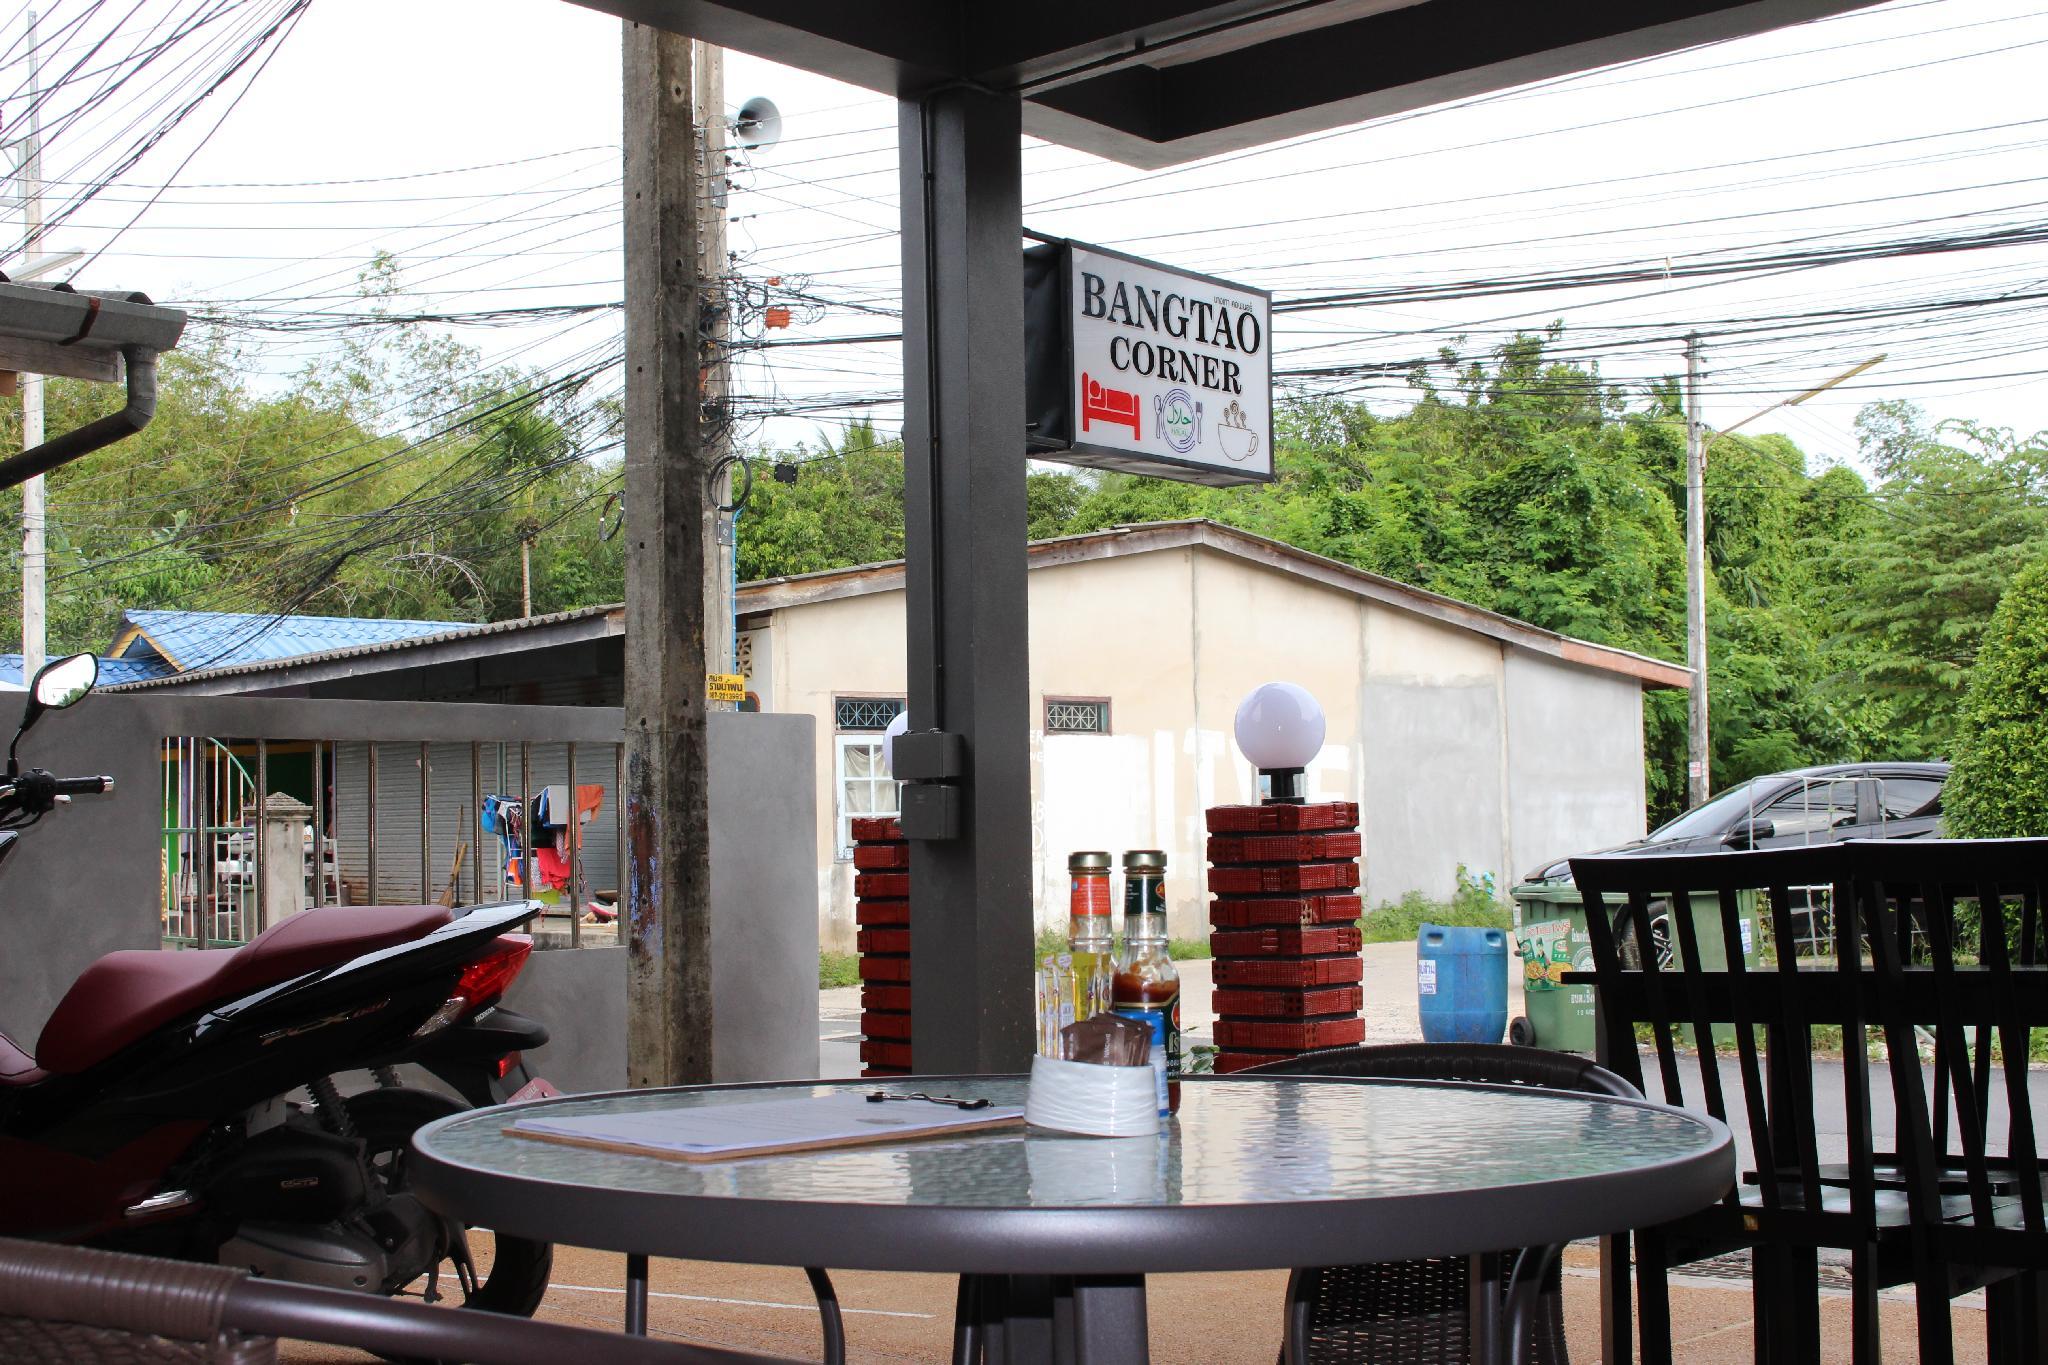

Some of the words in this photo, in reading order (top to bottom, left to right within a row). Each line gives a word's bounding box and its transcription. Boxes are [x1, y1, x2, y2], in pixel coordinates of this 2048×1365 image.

[1081, 271, 1261, 355] BANGTAO
[1110, 335, 1242, 395] CORNER
[1167, 404, 1191, 425] حلال
[474, 1006, 495, 1022] HONDA
